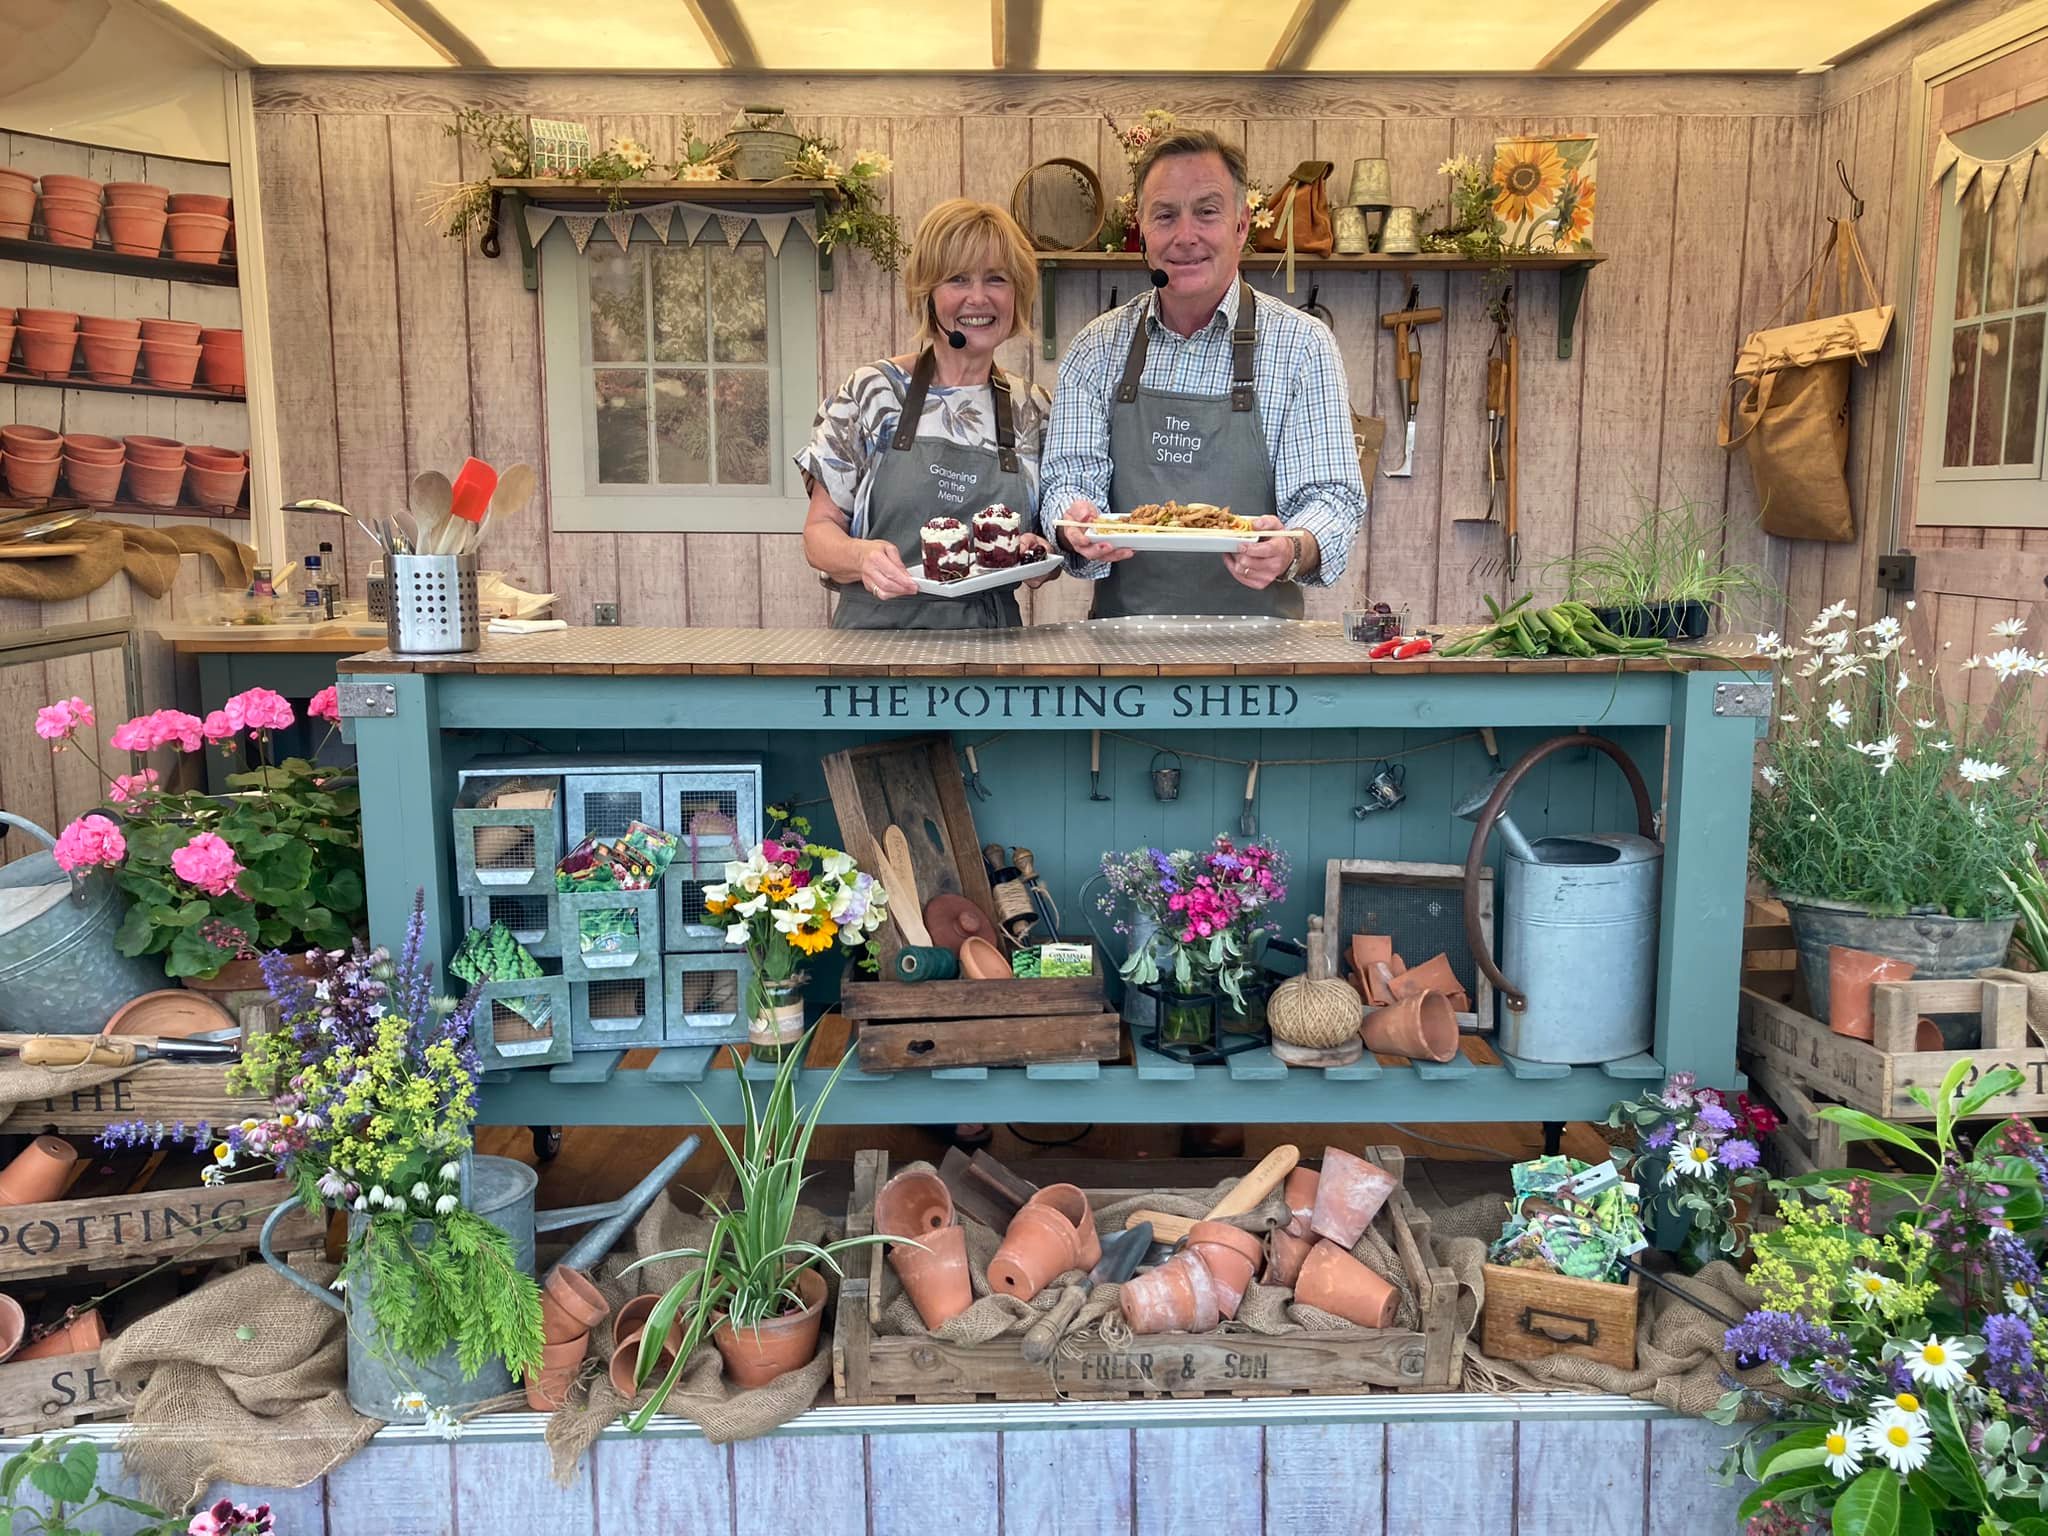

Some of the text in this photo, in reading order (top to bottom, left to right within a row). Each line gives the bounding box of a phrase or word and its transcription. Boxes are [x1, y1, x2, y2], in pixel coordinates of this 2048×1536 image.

[1165, 416, 1190, 430] The
[1152, 432, 1201, 450] Potting
[1156, 448, 1192, 463] Shed
[938, 480, 950, 489] on
[937, 490, 964, 503] Menu
[815, 684, 1298, 718] THE POTTING SHED
[1081, 1352, 1154, 1380] FREER
[1180, 1353, 1196, 1380] &
[1224, 1352, 1269, 1380] SON
[42, 1366, 147, 1416] SH
